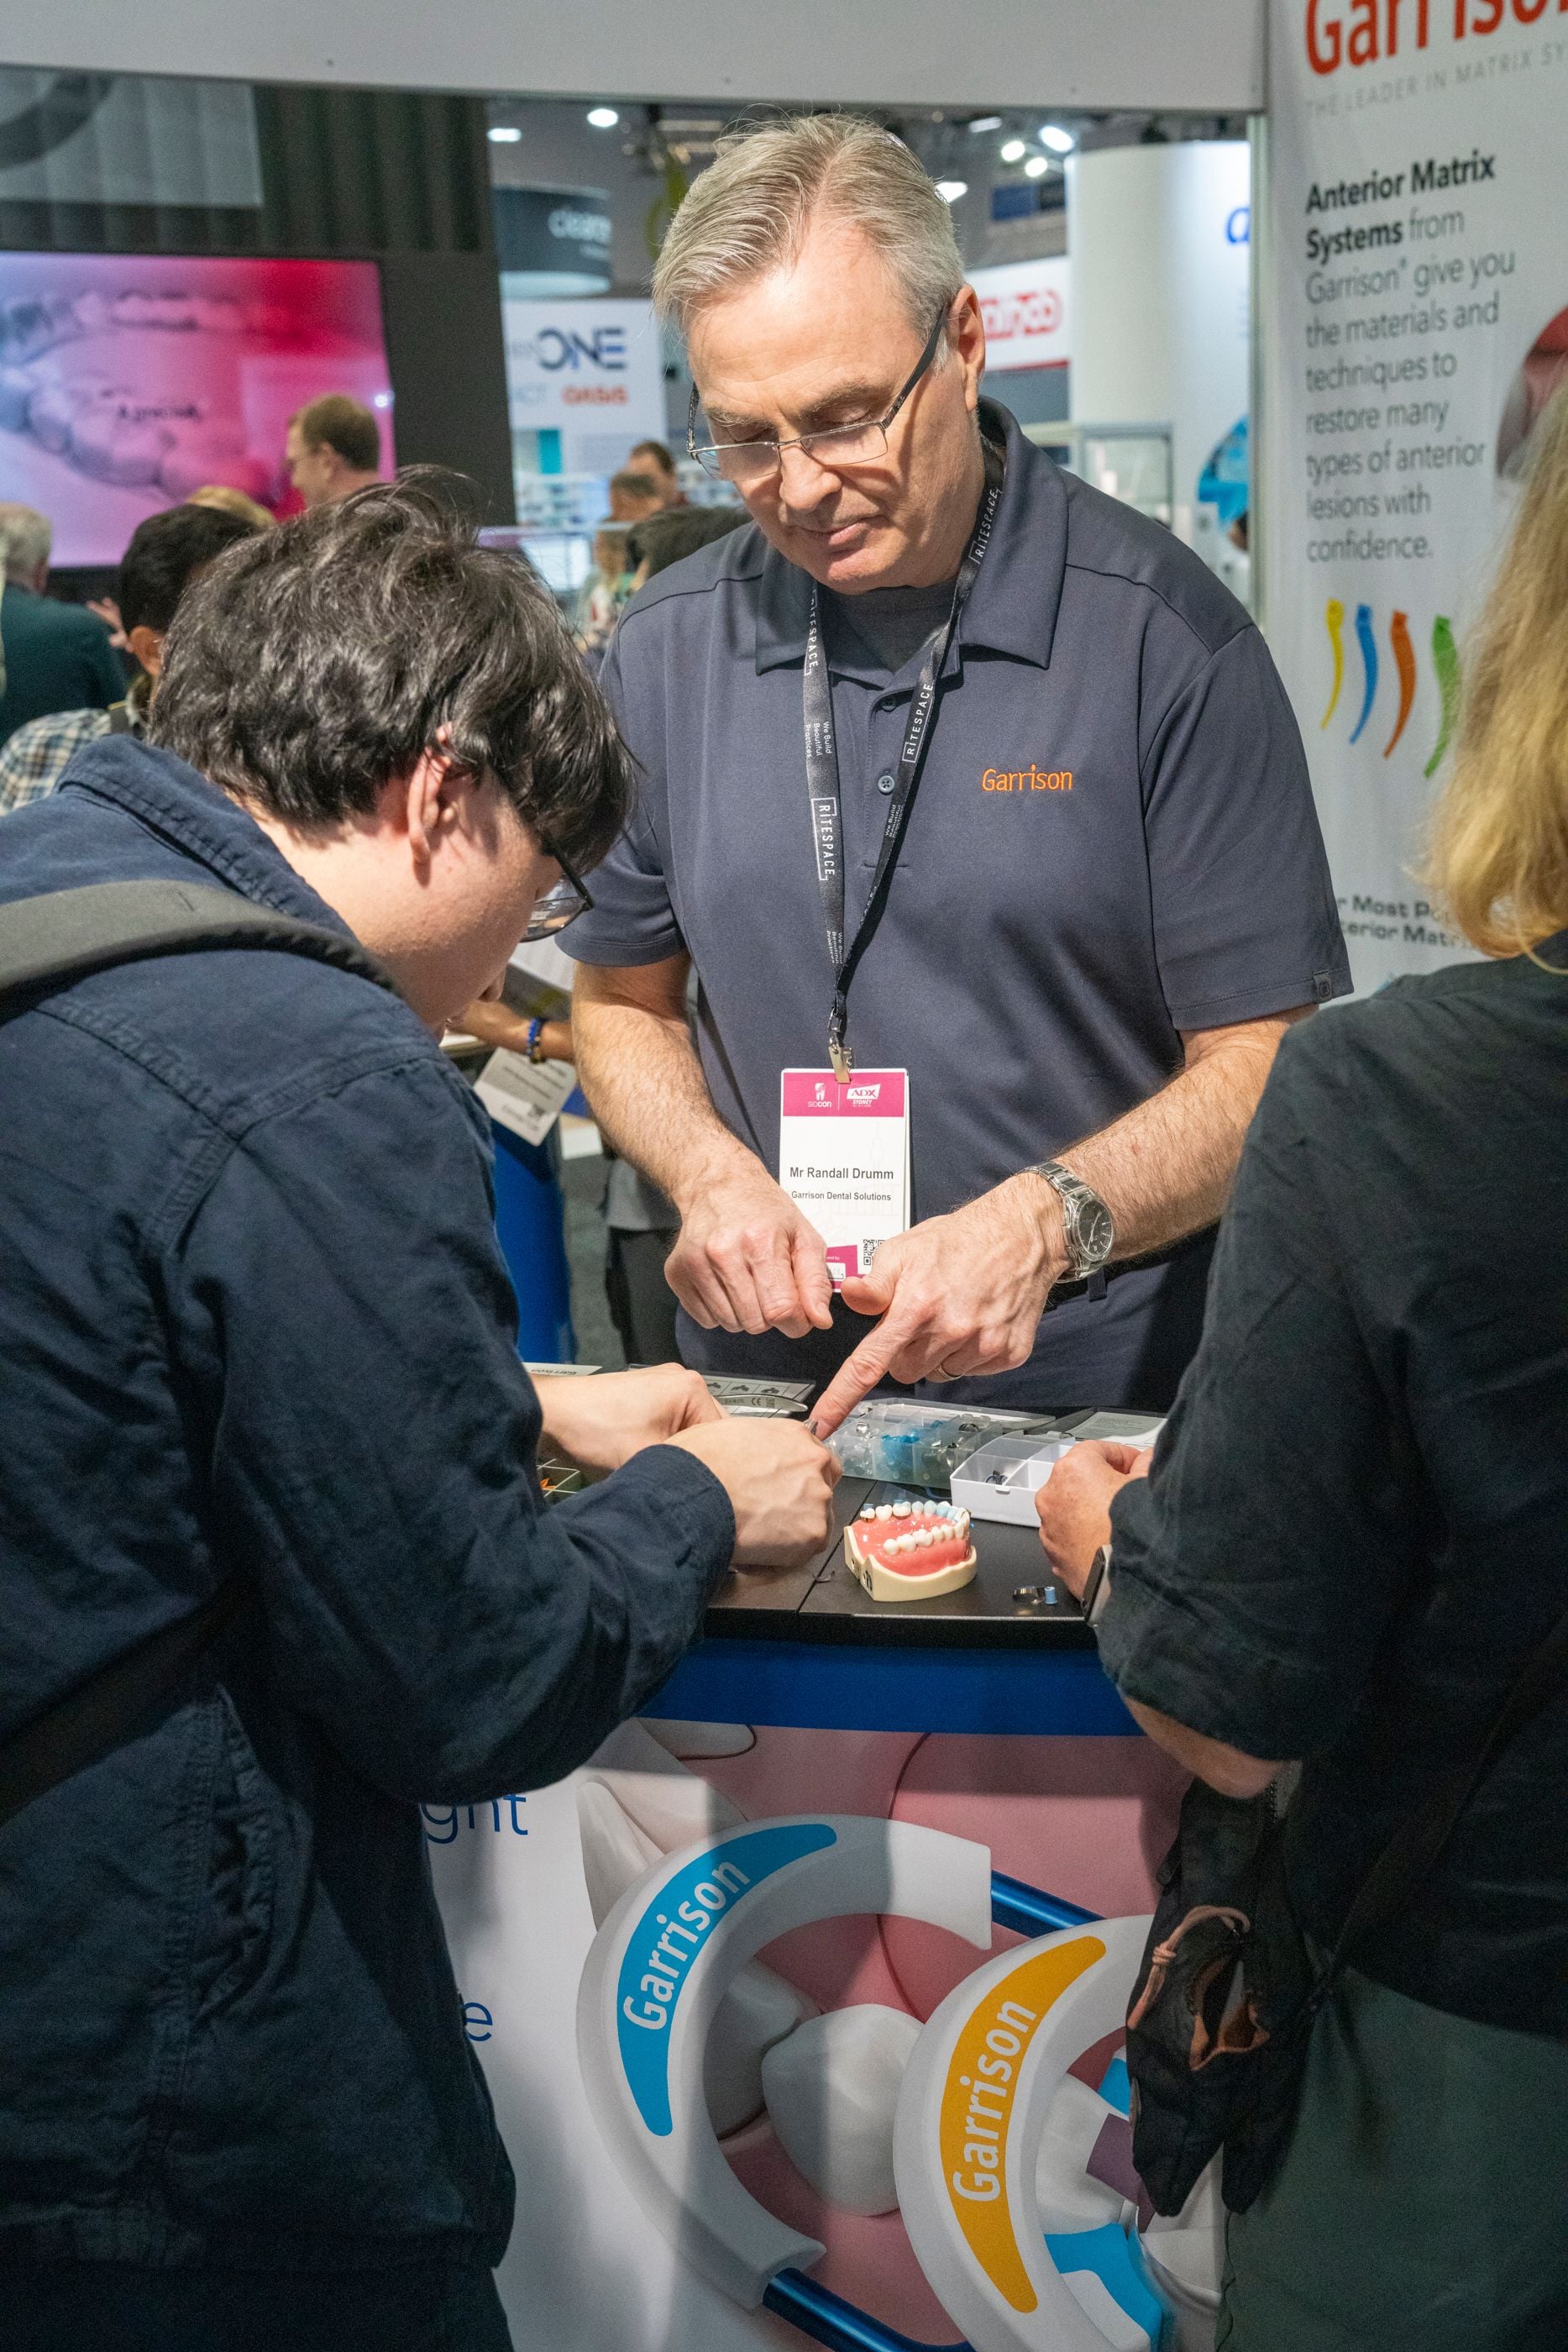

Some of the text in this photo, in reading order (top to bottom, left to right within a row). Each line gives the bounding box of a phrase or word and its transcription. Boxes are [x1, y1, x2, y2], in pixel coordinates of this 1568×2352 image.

[1345, 74, 1418, 113] LEADER
[1427, 67, 1448, 92] IN
[1455, 50, 1532, 86] MATRIX
[1305, 148, 1496, 214] Anterior Matrix
[1305, 207, 1465, 265] Systems from
[1413, 254, 1465, 297] give
[1470, 251, 1516, 291] you
[1306, 290, 1500, 349] the materials and
[1306, 351, 1458, 393] techniques to
[1306, 401, 1450, 435] restore many
[1306, 435, 1487, 487] types of anterior
[1306, 482, 1432, 521] lesions with
[974, 489, 999, 559] RITESPACE
[1306, 527, 1435, 563] confidence.
[814, 722, 823, 756] Beautiful
[823, 721, 832, 754] We Build
[907, 684, 933, 755] RITESPACE
[982, 763, 1072, 791] Garrison
[819, 805, 836, 875] RITESPACE
[1352, 894, 1408, 918] Most
[851, 1089, 878, 1098] ADX
[789, 1167, 894, 1179] Mr Randall Drumm
[791, 1190, 891, 1201] Garrison Dental Solutions
[623, 1857, 750, 2031] Garrison
[953, 1999, 1036, 2202] Garrison
